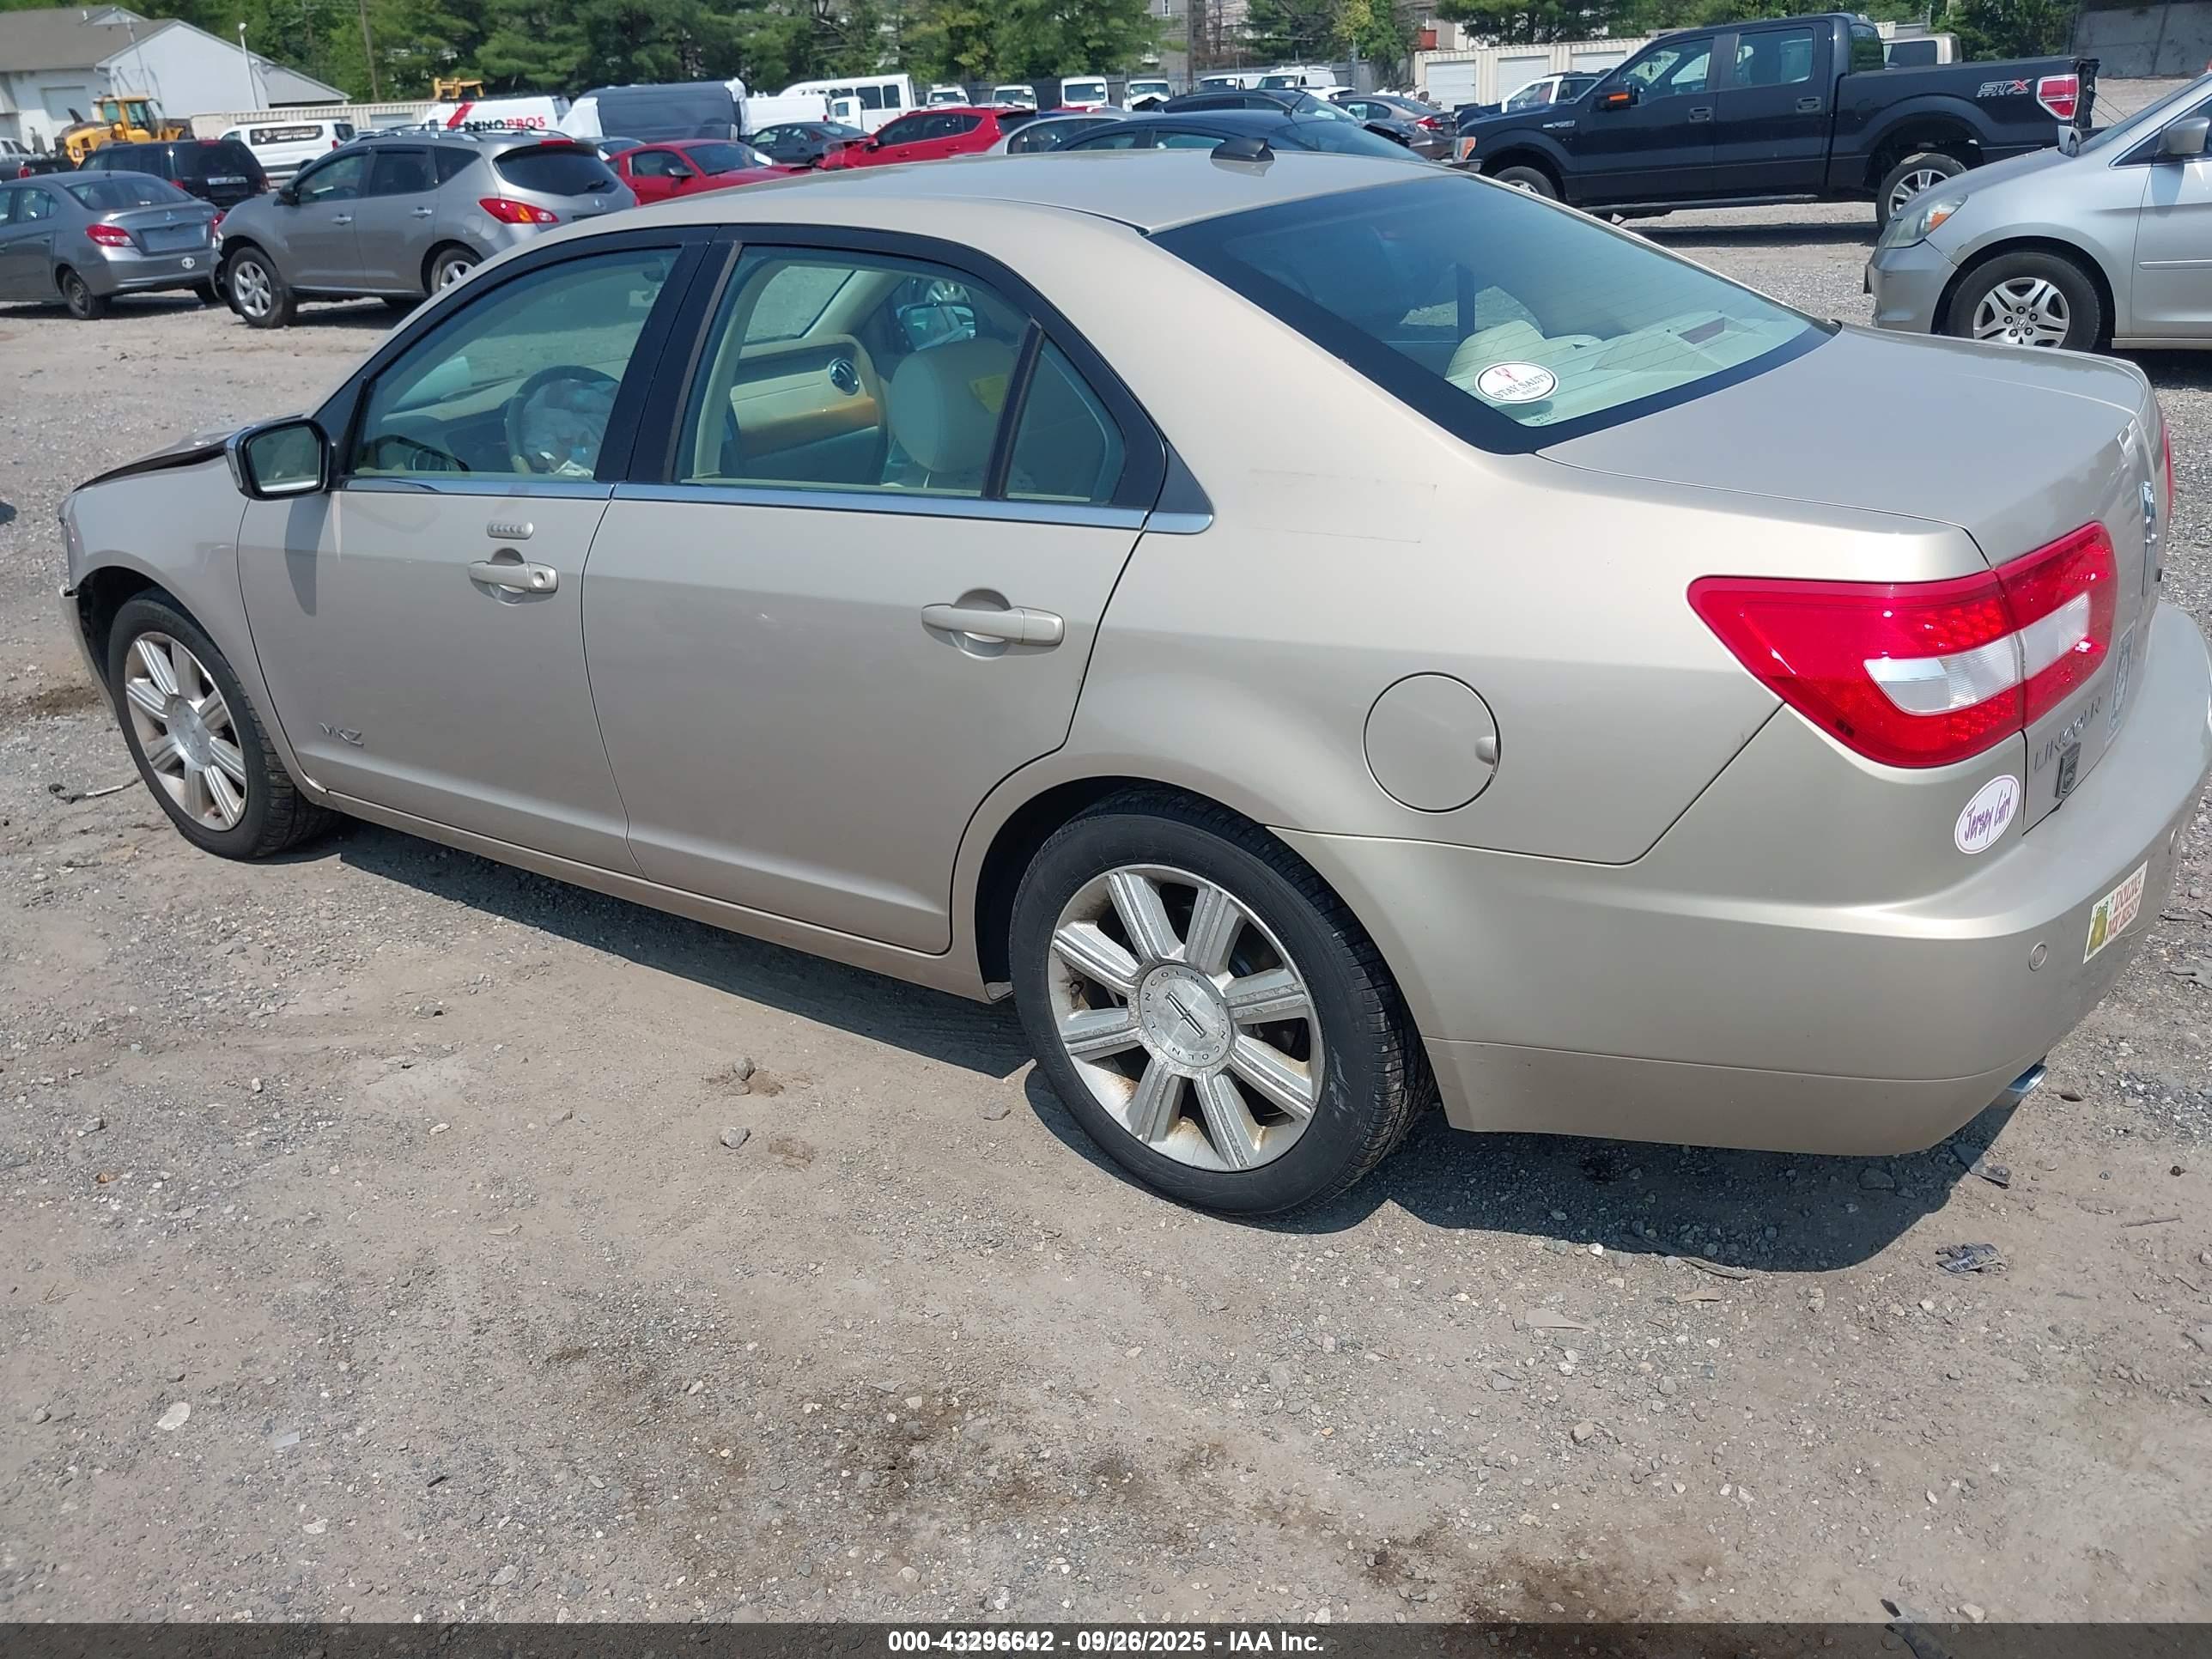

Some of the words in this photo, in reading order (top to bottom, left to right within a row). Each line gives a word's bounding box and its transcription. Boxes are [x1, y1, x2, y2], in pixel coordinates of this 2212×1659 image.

[1978, 78, 2033, 94] STX
[1493, 384, 1520, 398] STAY
[1517, 373, 1551, 389] SALTY
[1964, 804, 1994, 843] Jersey
[1145, 970, 1199, 1029] LINCOLN
[1171, 1001, 1226, 1060] LINCOLN
